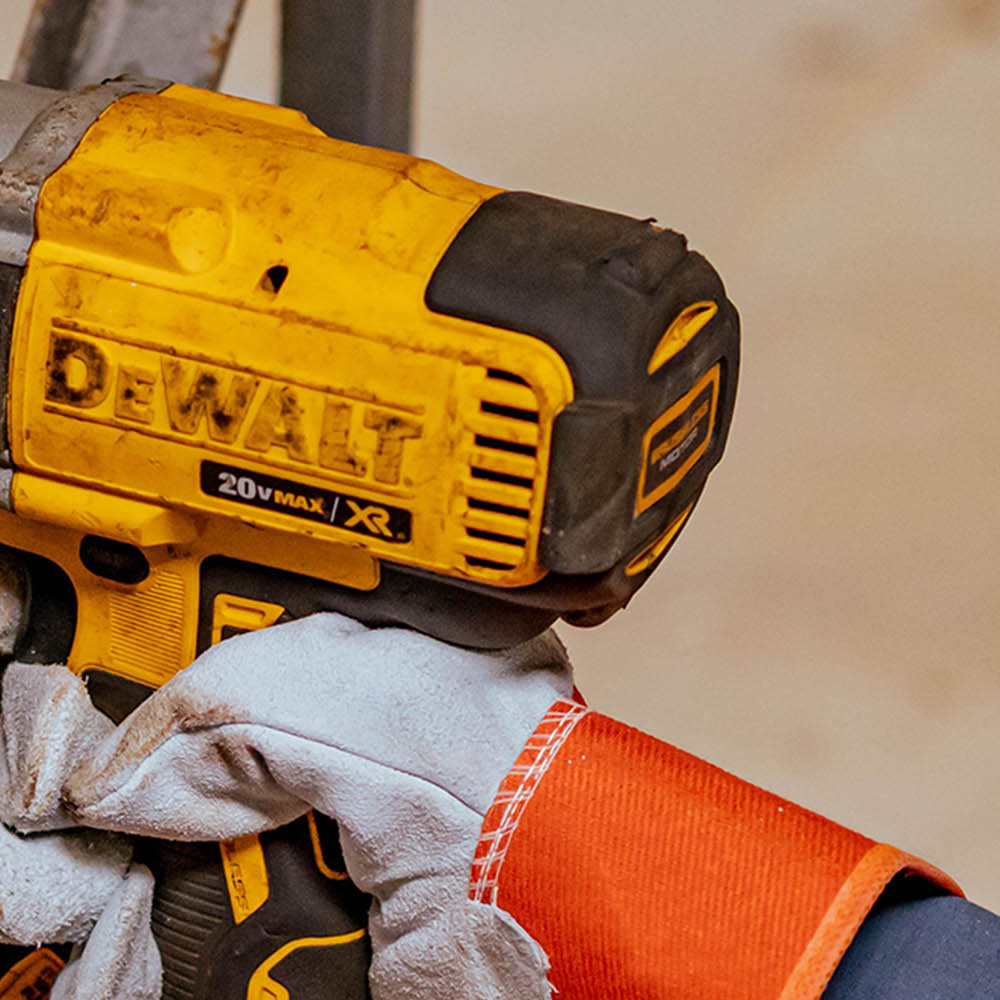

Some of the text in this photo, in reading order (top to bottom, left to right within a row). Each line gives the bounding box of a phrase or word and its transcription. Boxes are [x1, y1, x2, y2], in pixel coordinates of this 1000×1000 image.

[45, 331, 423, 485] DEWALT
[274, 490, 324, 516] MAX
[344, 499, 393, 538] XR
